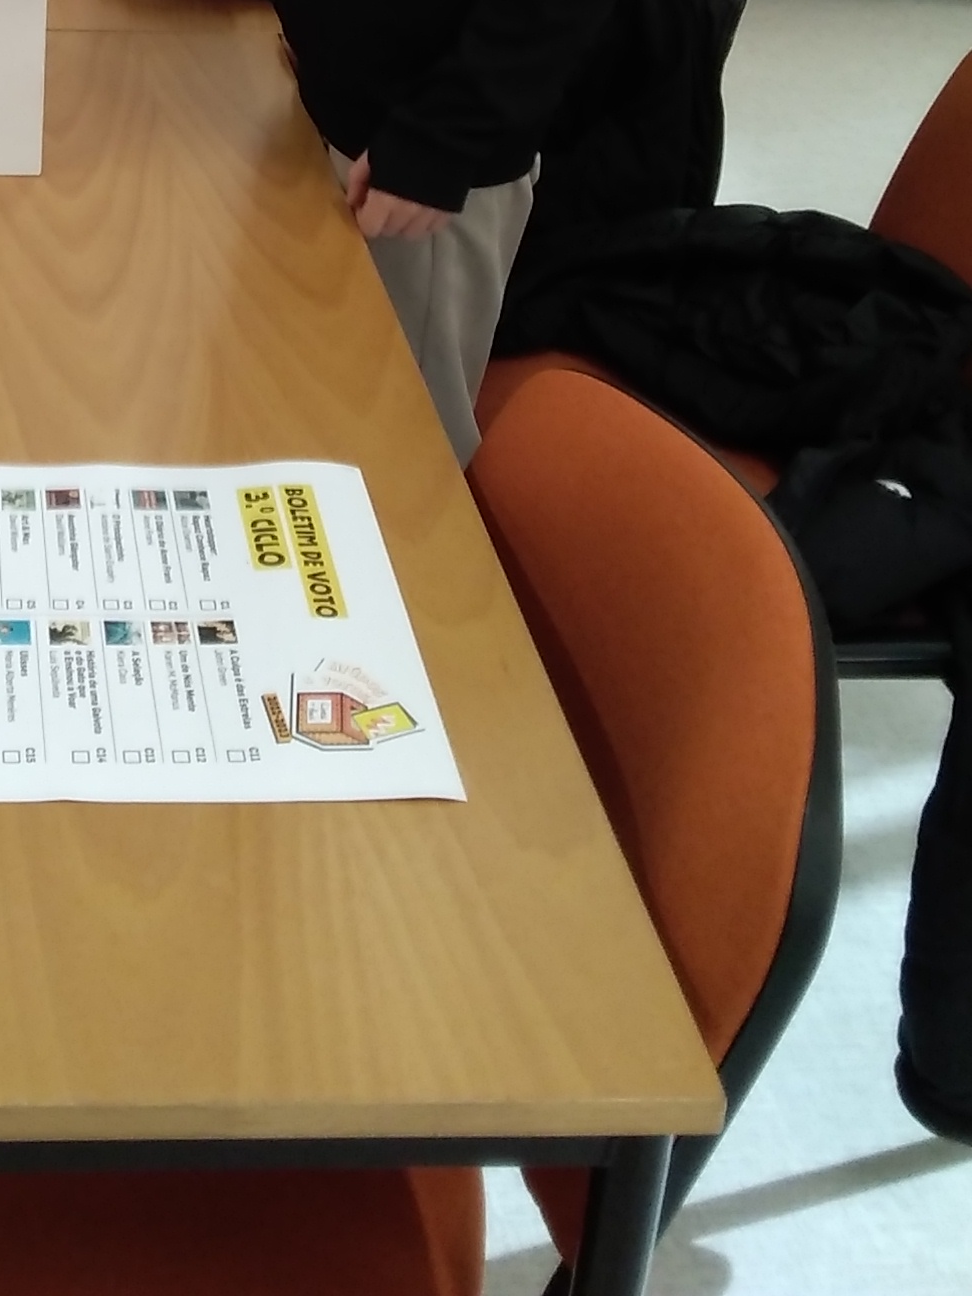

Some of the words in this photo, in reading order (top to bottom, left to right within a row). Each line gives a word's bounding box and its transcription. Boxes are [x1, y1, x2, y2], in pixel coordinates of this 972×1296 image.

[283, 487, 320, 546] BOLETIM
[248, 518, 287, 566] CICLO
[299, 550, 325, 567] DE
[305, 570, 340, 618] VOTO
[19, 650, 29, 676] Ulisses
[75, 656, 84, 665] do
[178, 650, 188, 662] Um
[181, 664, 190, 672] de
[229, 656, 242, 676] Culpa
[88, 679, 98, 688] de
[234, 683, 246, 696] das
[89, 690, 100, 705] uma
[185, 689, 197, 712] Mente
[237, 698, 253, 729] Estrelas
[25, 747, 35, 762] C15
[95, 747, 107, 762] C14
[144, 747, 155, 763] C13
[194, 747, 206, 762] C12
[248, 747, 260, 761] C11
